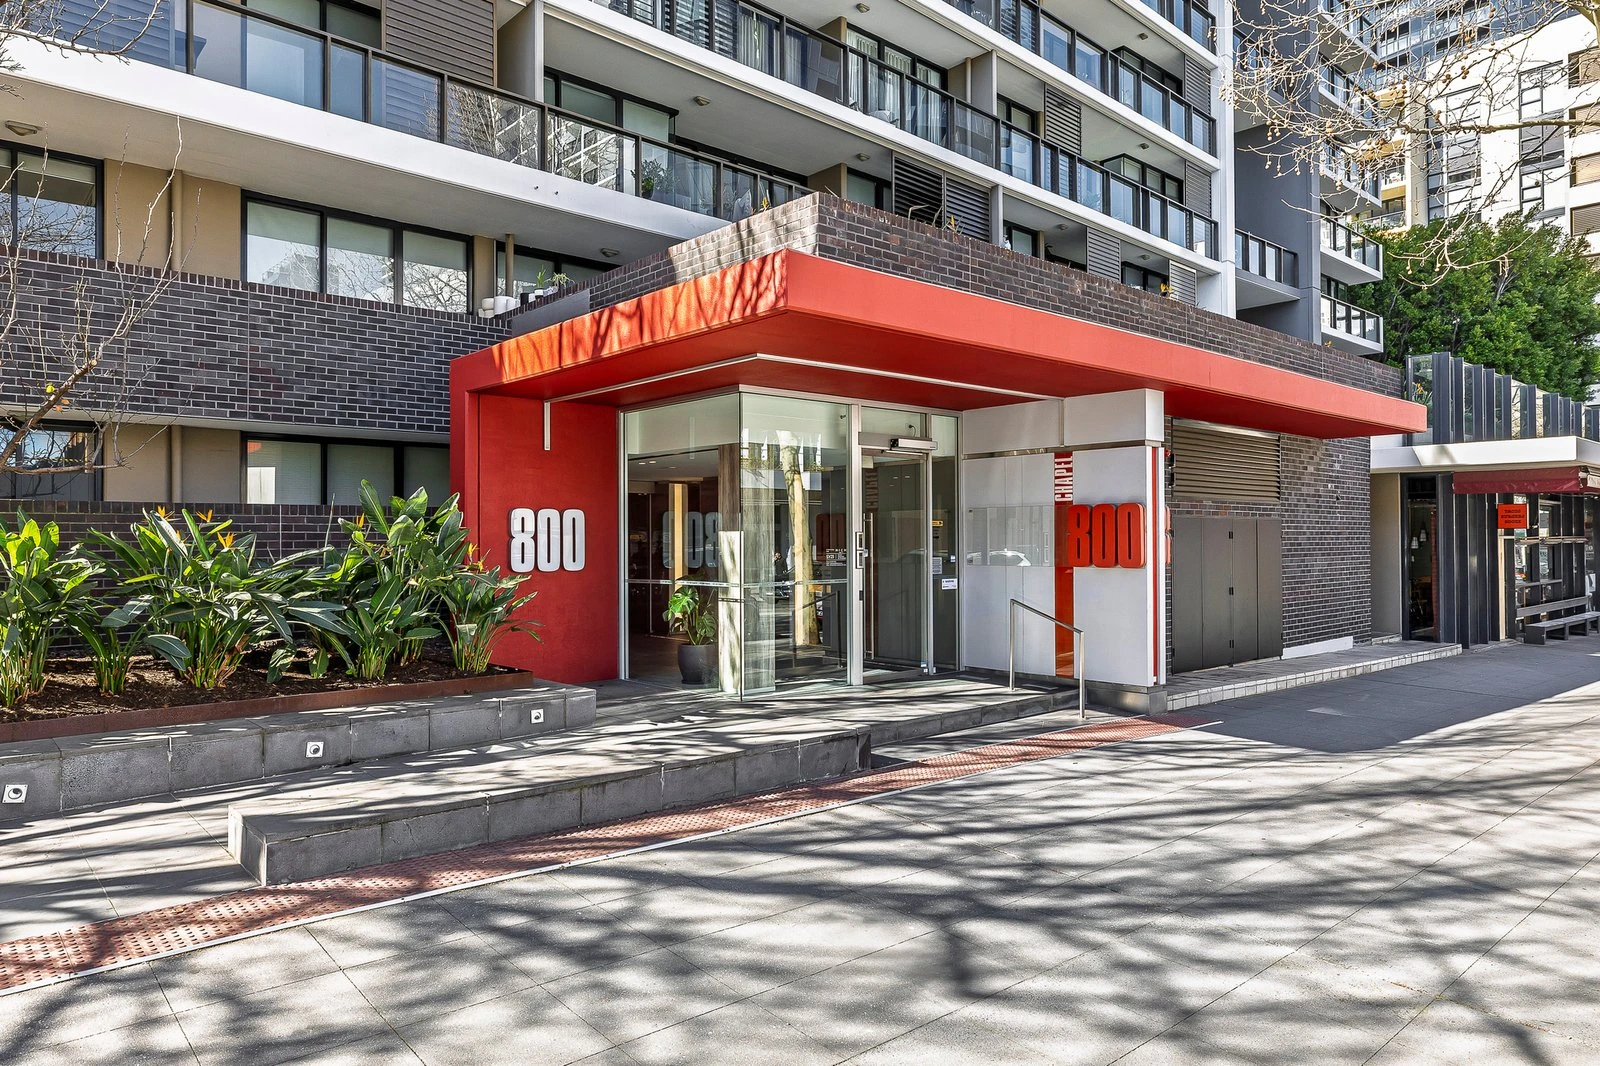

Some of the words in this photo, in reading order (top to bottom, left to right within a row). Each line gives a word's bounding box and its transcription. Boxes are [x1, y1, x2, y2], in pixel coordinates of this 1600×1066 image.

[1054, 456, 1073, 502] CHAPEL
[510, 507, 586, 573] 800
[1068, 502, 1146, 568] 800
